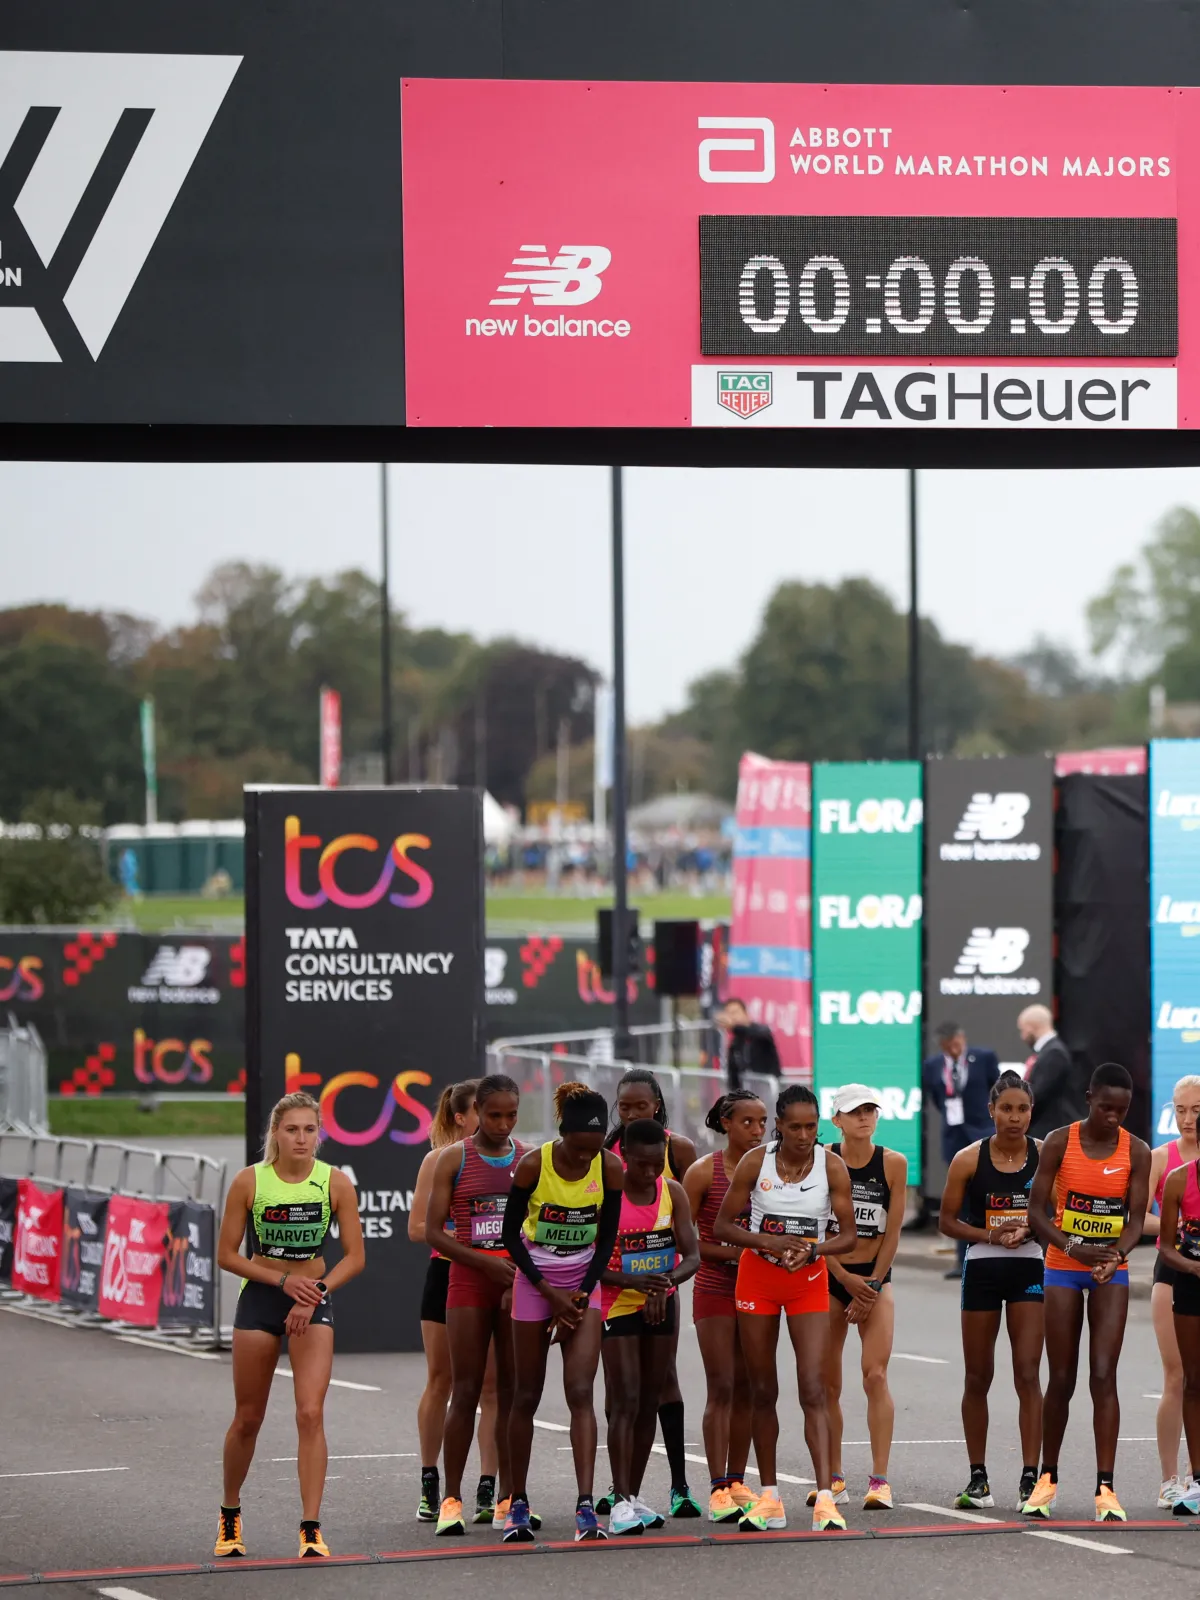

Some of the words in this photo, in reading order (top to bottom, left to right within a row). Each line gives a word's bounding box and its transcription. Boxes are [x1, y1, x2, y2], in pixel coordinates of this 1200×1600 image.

[789, 126, 893, 148] ABBOTT
[789, 153, 885, 176] WORLD
[894, 154, 1049, 177] MARATHON
[1061, 155, 1171, 178] MAJORS
[738, 254, 1139, 335] 00:00:00
[465, 316, 519, 338] new
[523, 314, 631, 338] balance
[721, 373, 769, 390] TAG
[721, 391, 770, 409] HEUER
[939, 843, 972, 861] new
[974, 841, 1041, 861] balance
[284, 814, 434, 910] tcs
[285, 927, 358, 950] TATA
[285, 952, 455, 976] CONSULTANCY
[285, 979, 394, 1003] SERVICES
[939, 978, 972, 995] new
[974, 976, 1041, 996] balance
[133, 1027, 214, 1084] tcs
[474, 1200, 496, 1213] tcs
[990, 1194, 1011, 1208] tcs
[1070, 1194, 1091, 1211] tcs
[265, 1208, 288, 1221] tcs
[543, 1207, 565, 1221] tcs
[763, 1218, 784, 1232] tcs
[1072, 1218, 1113, 1234] KORIR
[265, 1228, 318, 1243] HARVEY
[545, 1229, 588, 1241] MELLY
[625, 1237, 646, 1251] tcs
[631, 1256, 661, 1272] PACE
[663, 1255, 669, 1267] 1
